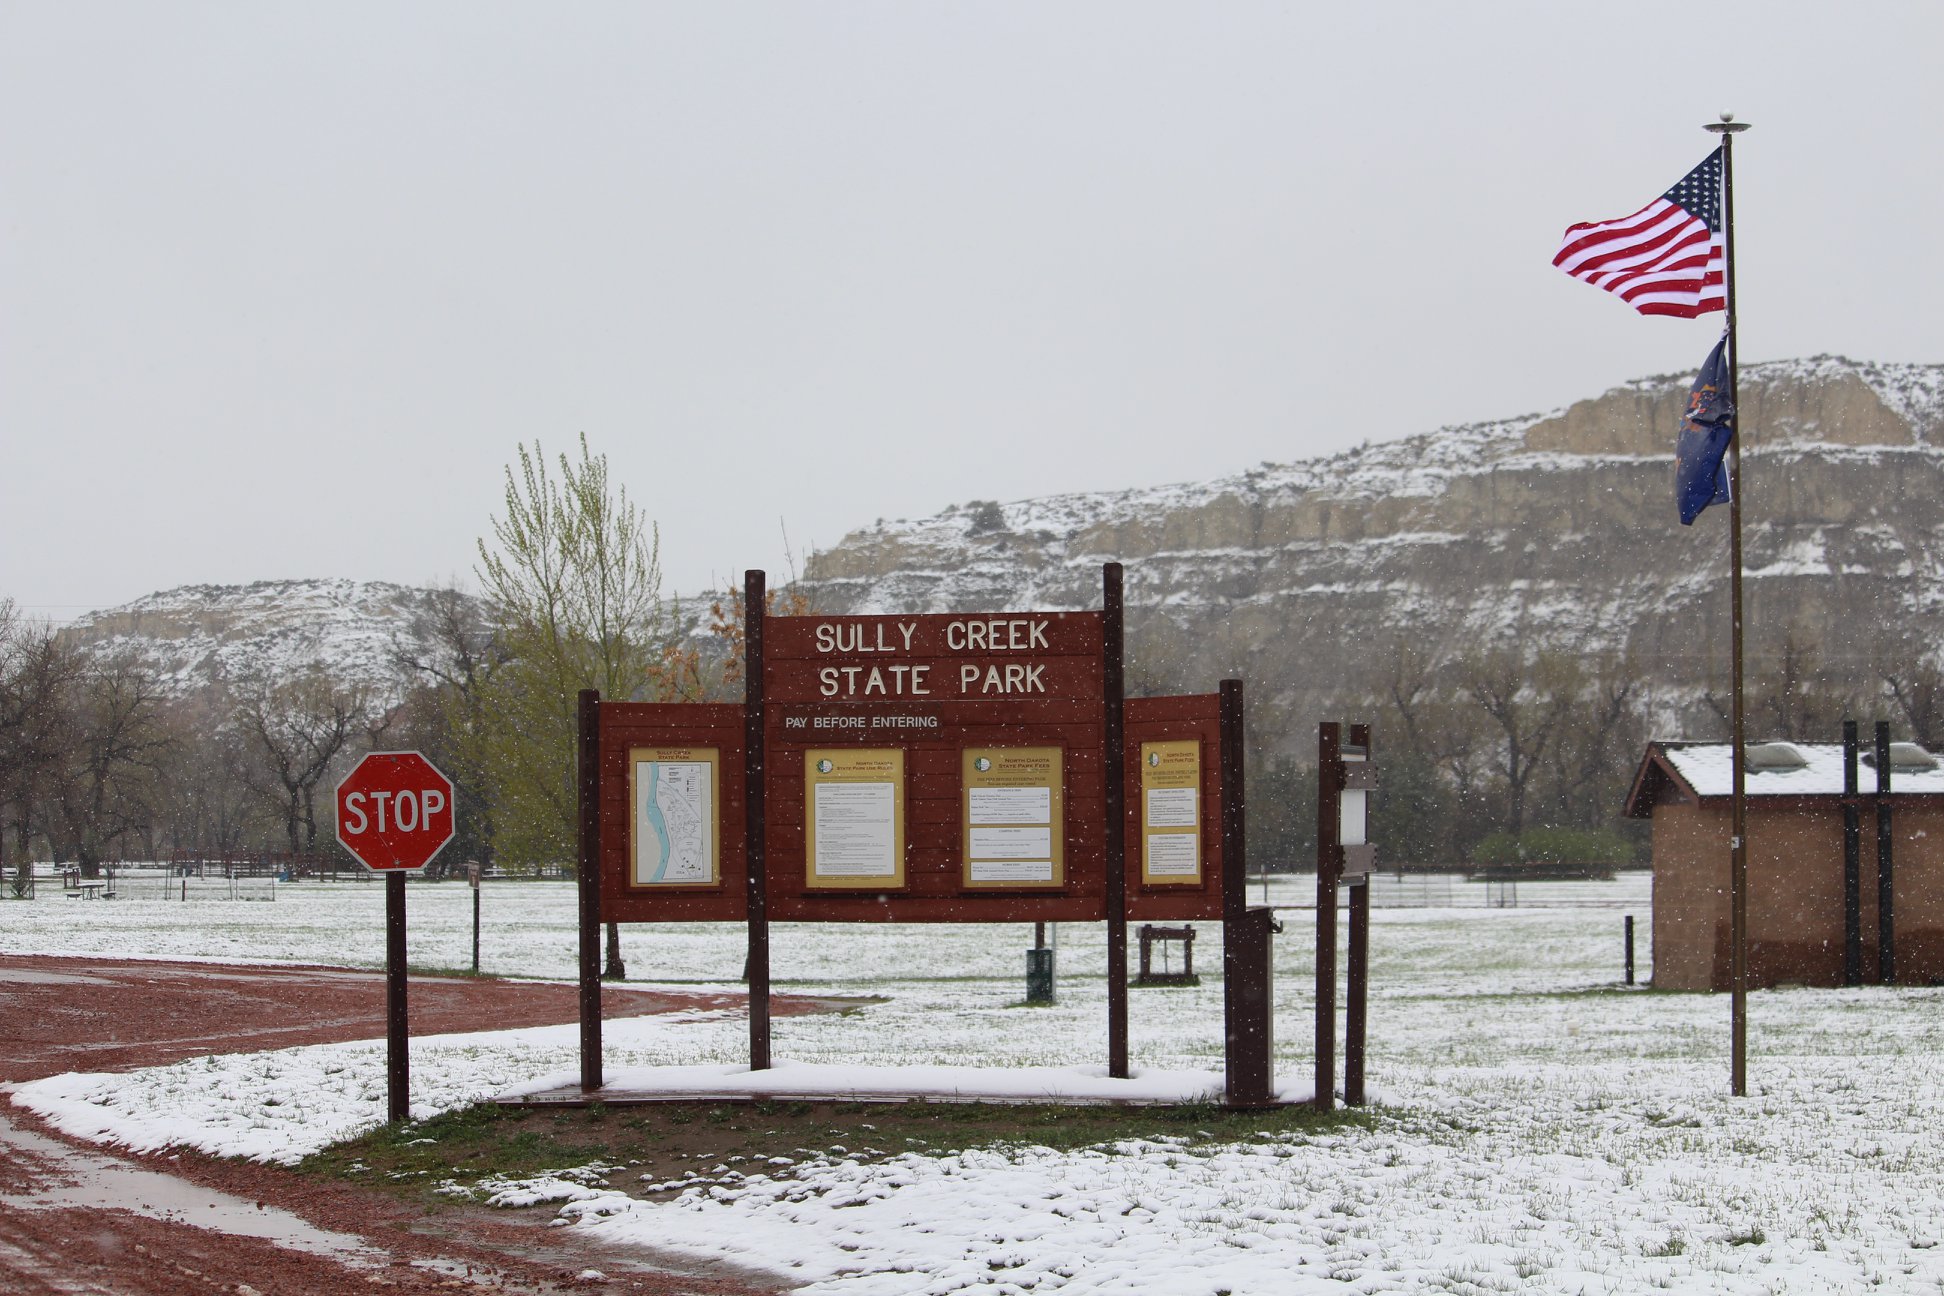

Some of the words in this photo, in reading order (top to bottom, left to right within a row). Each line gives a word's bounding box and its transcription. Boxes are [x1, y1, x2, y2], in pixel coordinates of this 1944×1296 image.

[816, 622, 917, 653] SULLY
[947, 620, 1049, 650] CREEK
[820, 665, 930, 696] STATE
[960, 664, 1046, 693] PARK
[785, 717, 808, 728] PAY
[814, 716, 866, 728] BEFORE
[872, 716, 938, 728] ENTERING
[345, 789, 445, 835] STOP
